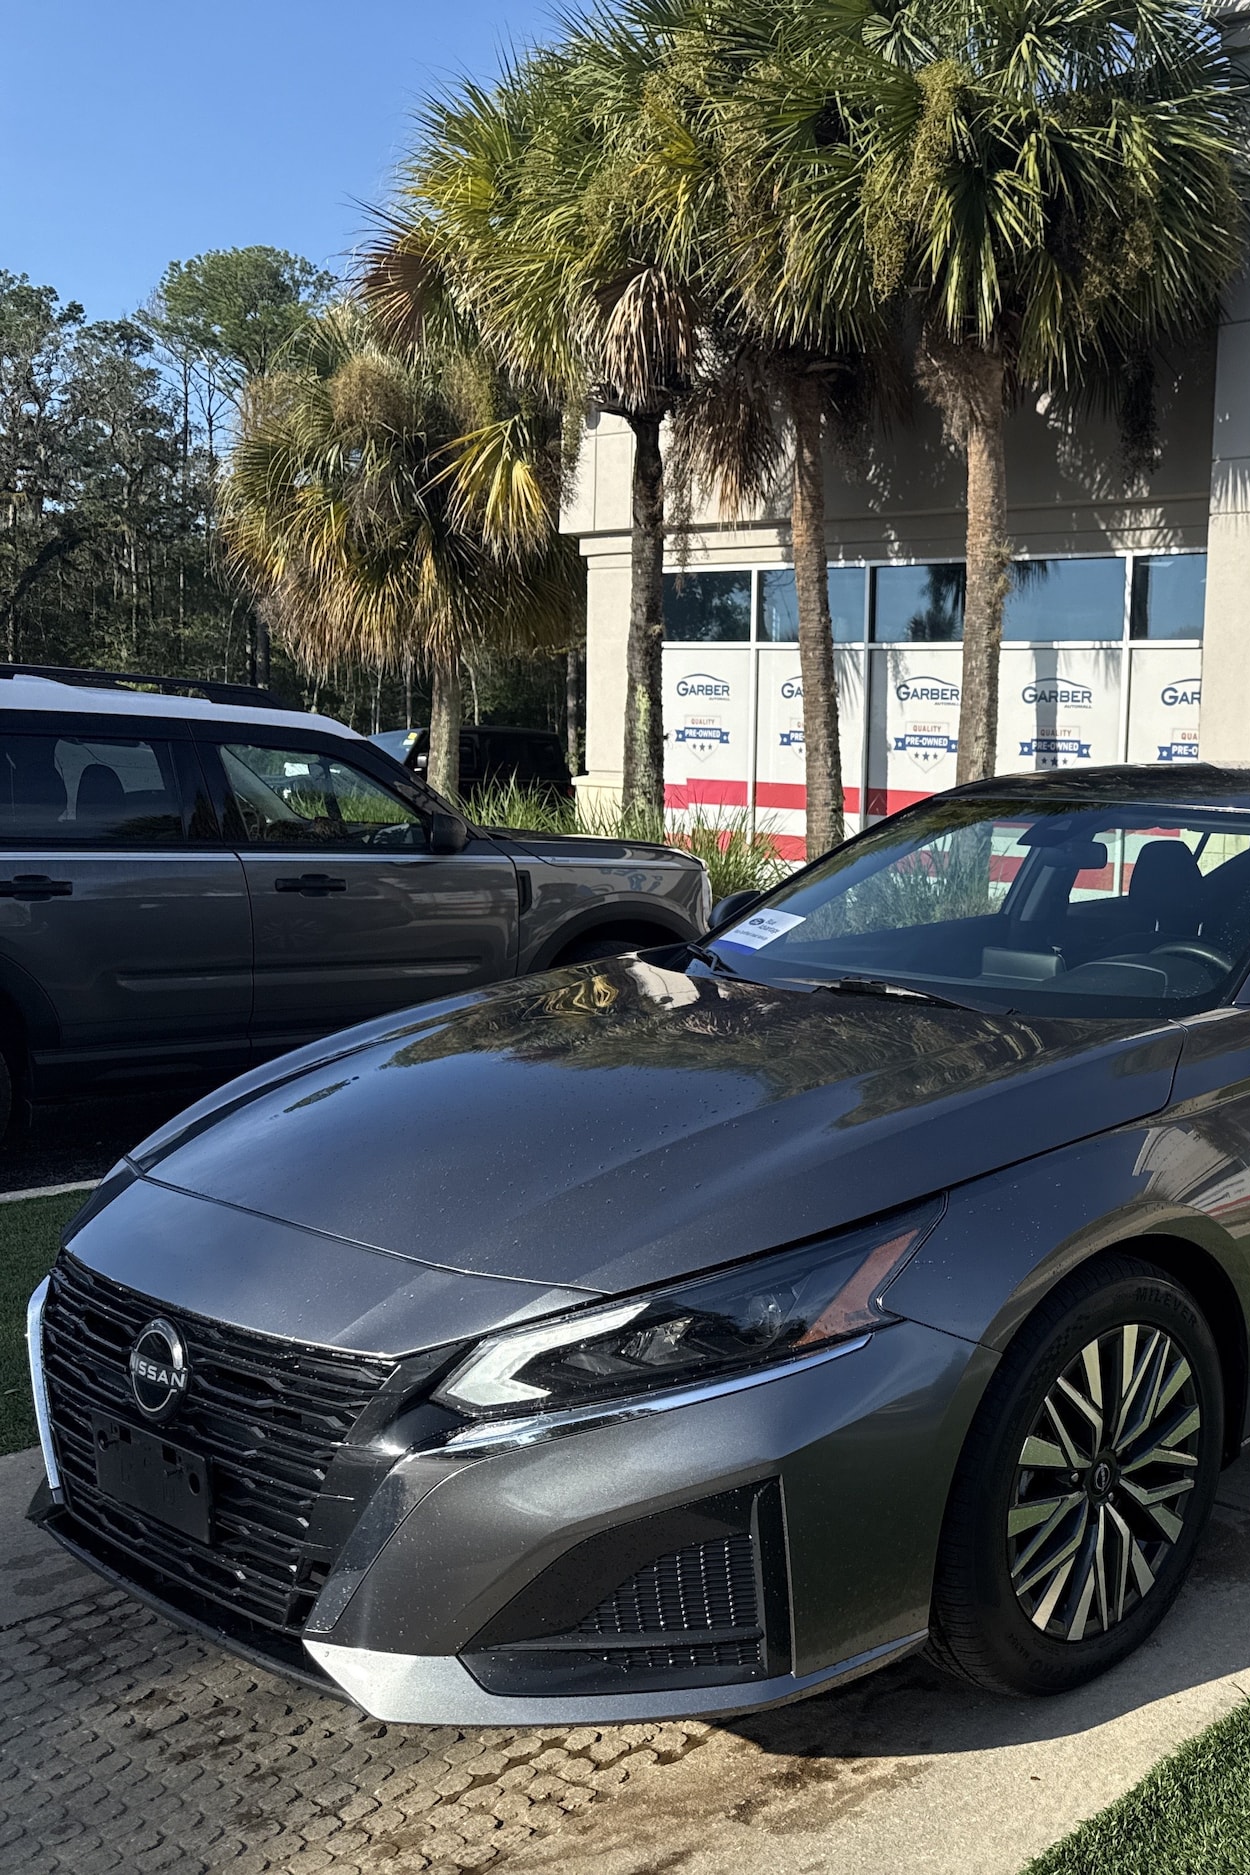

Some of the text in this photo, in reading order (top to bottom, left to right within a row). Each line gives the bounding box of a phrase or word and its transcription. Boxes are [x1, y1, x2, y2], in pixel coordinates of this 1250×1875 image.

[676, 681, 730, 696] GARBER
[896, 684, 960, 701] GARBER
[1022, 686, 1092, 704] GARBER
[691, 718, 715, 726] QUALITY
[684, 729, 720, 738] PRE-OWNED
[905, 736, 948, 746] PRE-OWNED
[1032, 741, 1079, 750] PRE-OWNED
[130, 1351, 185, 1388] NISSAN
